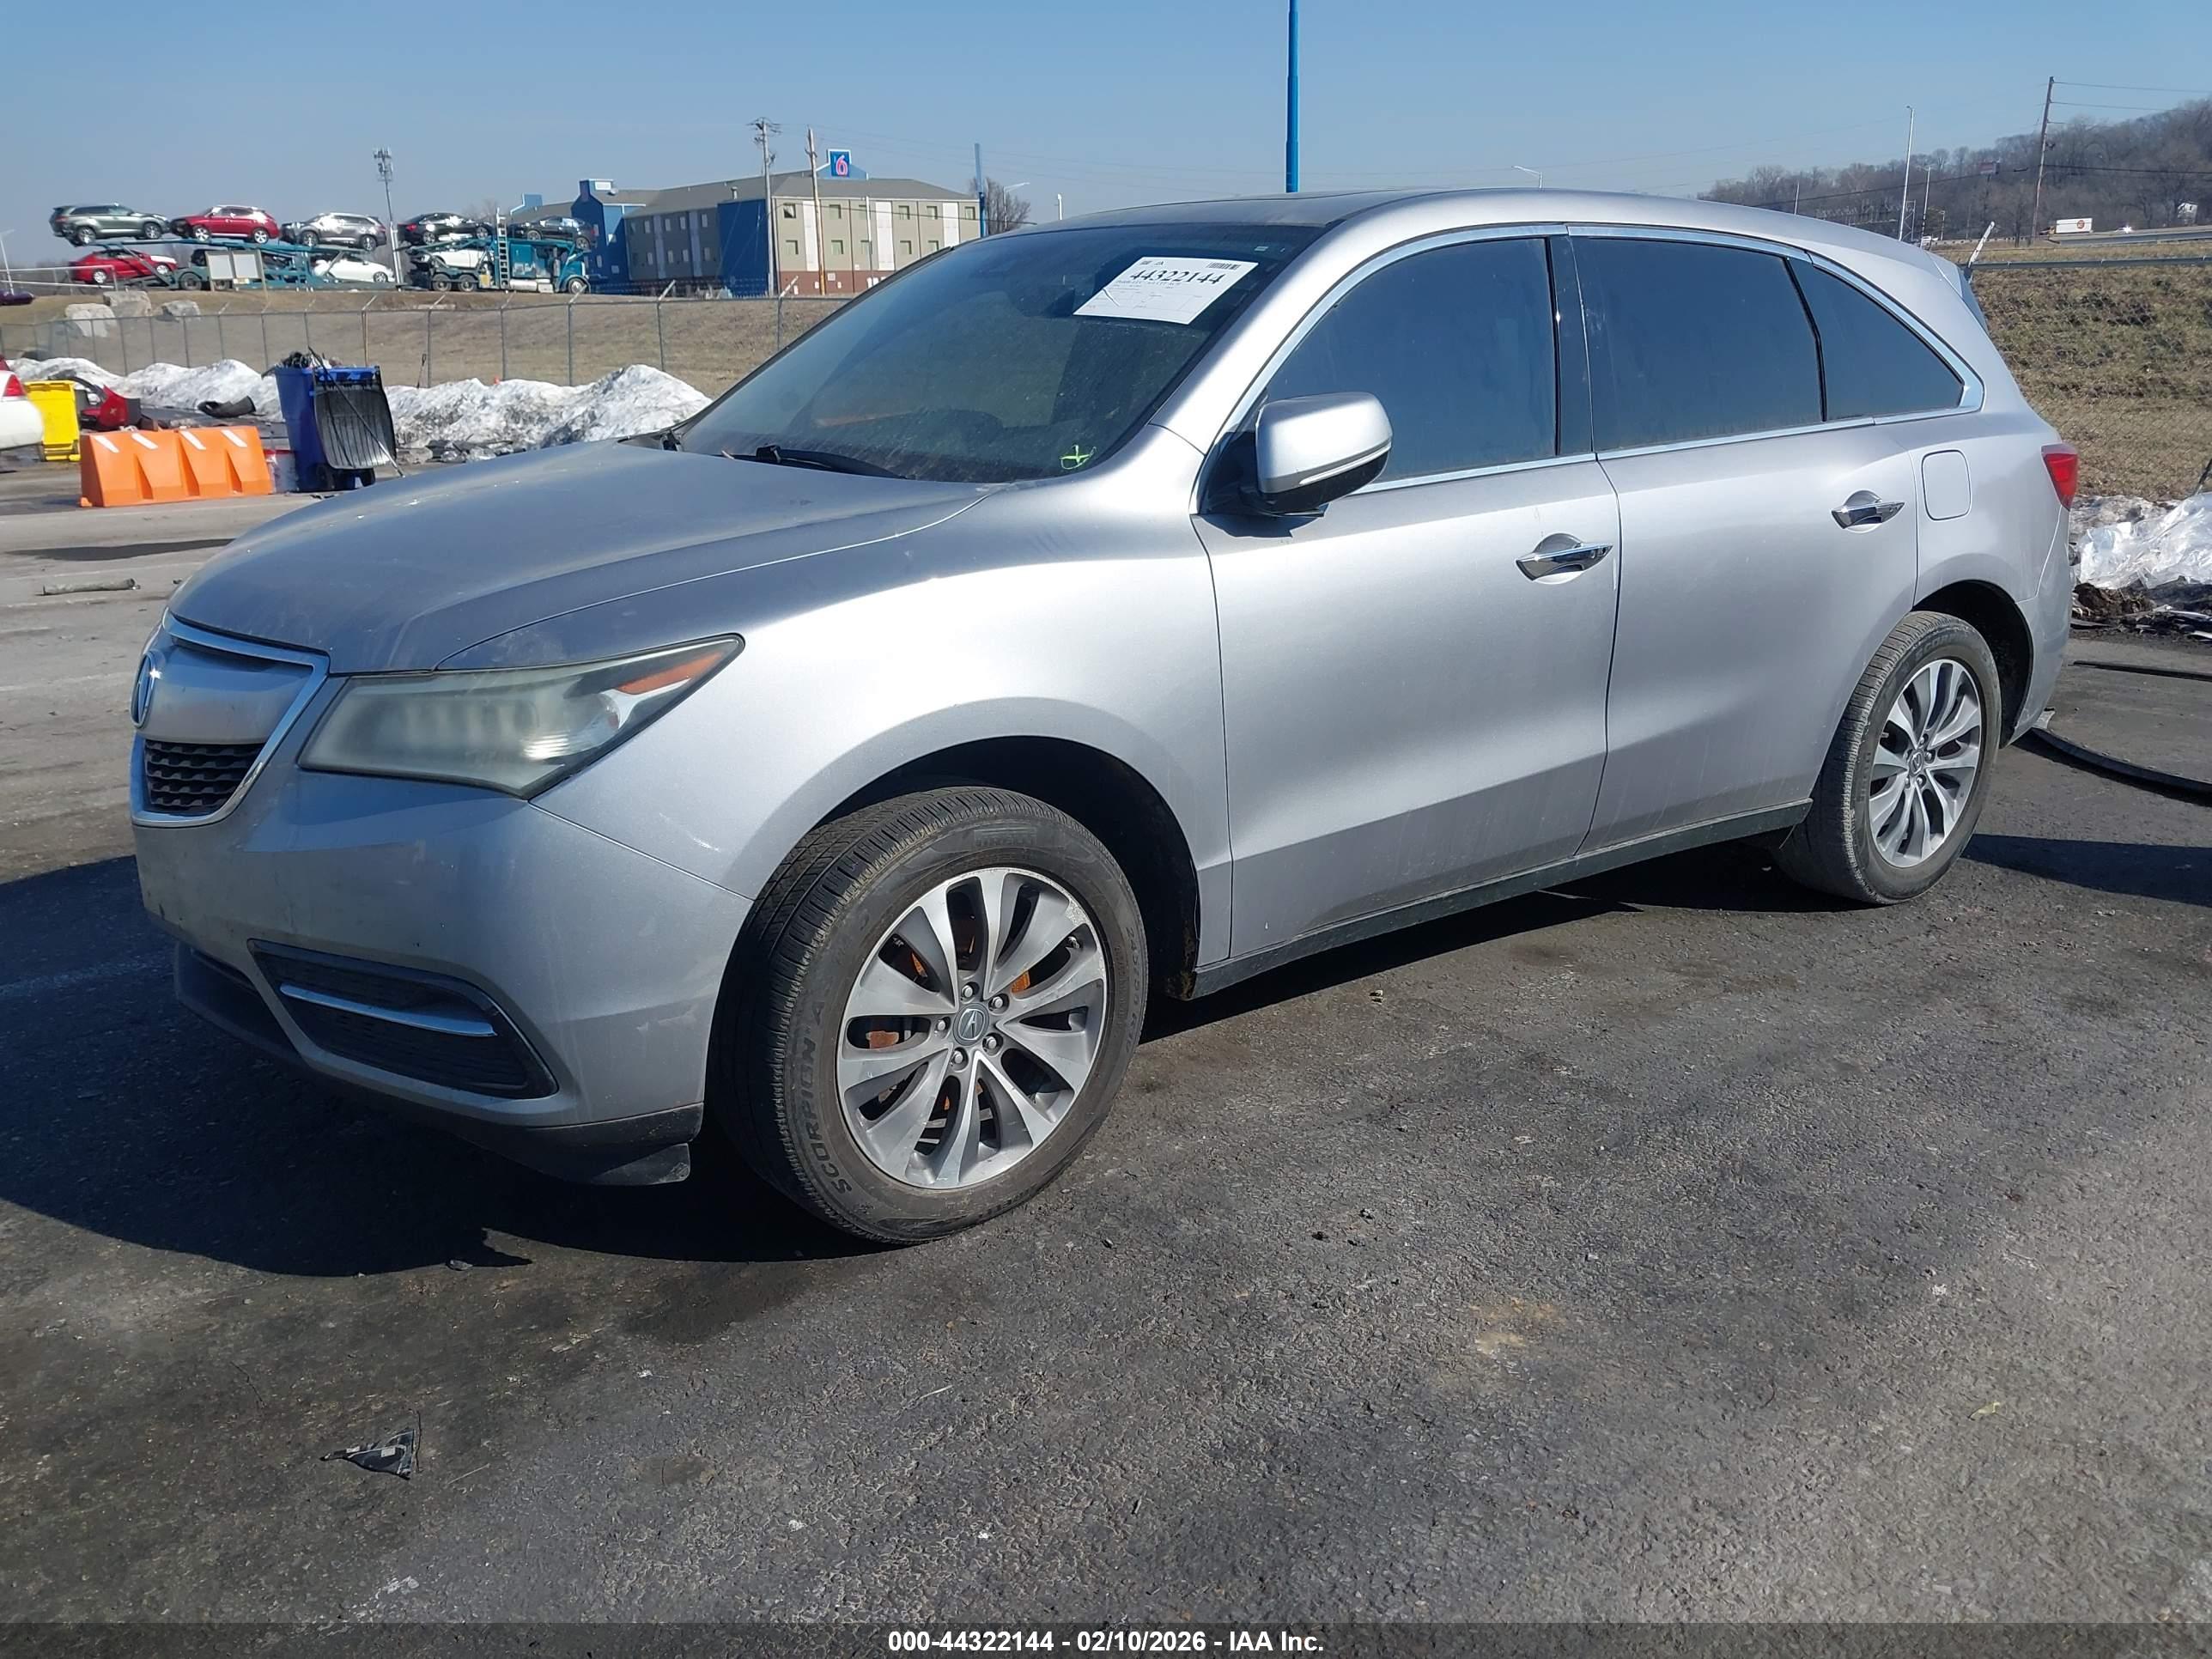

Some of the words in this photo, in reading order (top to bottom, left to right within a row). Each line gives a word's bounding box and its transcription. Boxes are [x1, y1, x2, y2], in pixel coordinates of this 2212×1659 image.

[836, 155, 848, 176] 6
[1130, 270, 1226, 284] 44322144
[799, 1036, 853, 1195] SCORPION
